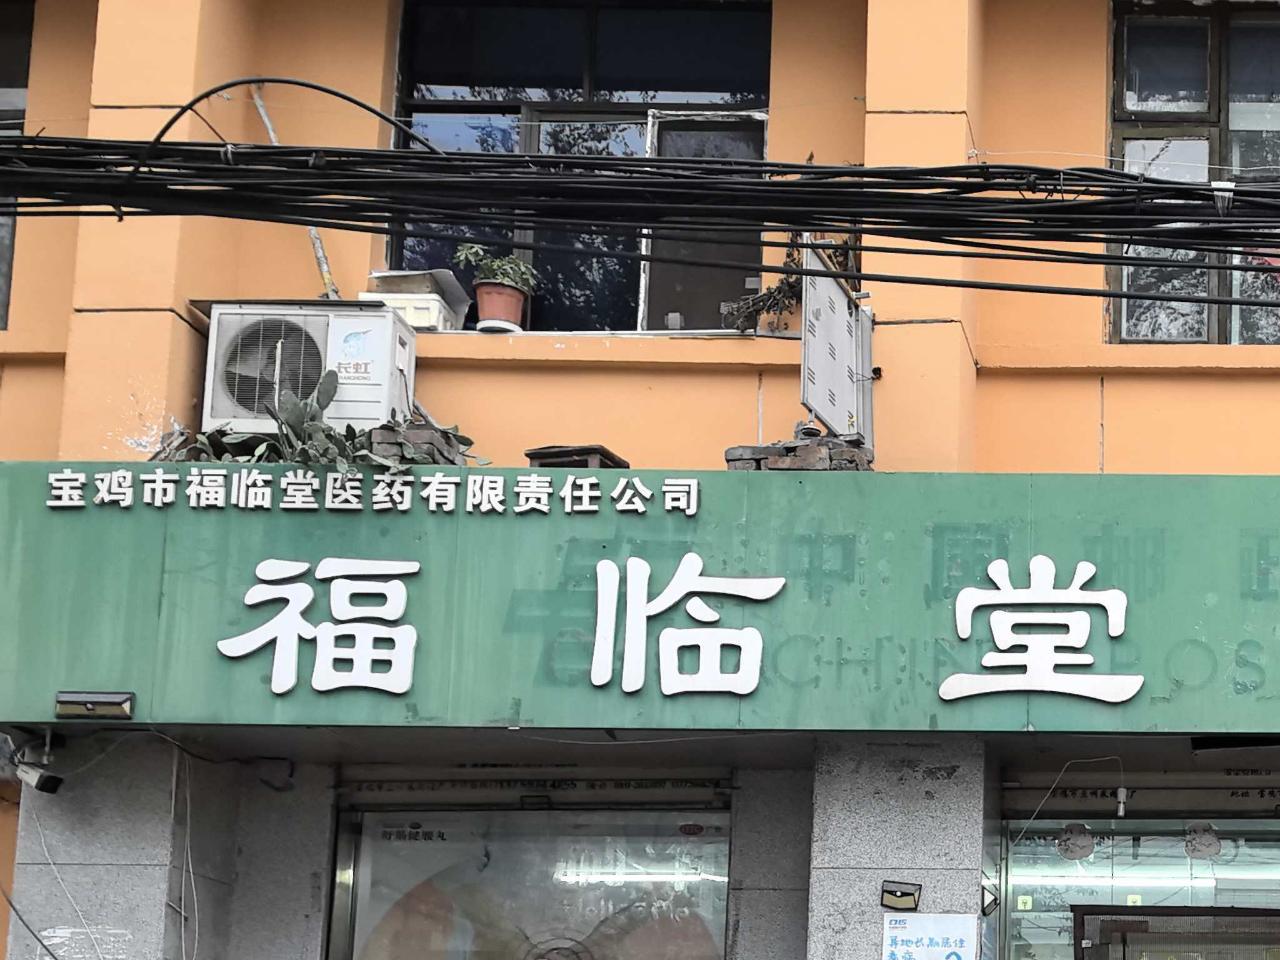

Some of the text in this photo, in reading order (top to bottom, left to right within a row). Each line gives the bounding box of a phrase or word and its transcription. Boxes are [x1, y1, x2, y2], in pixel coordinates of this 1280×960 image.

[337, 361, 371, 374] 长虹
[47, 468, 700, 515] 宝鸡市福临堂医药有限责任公司
